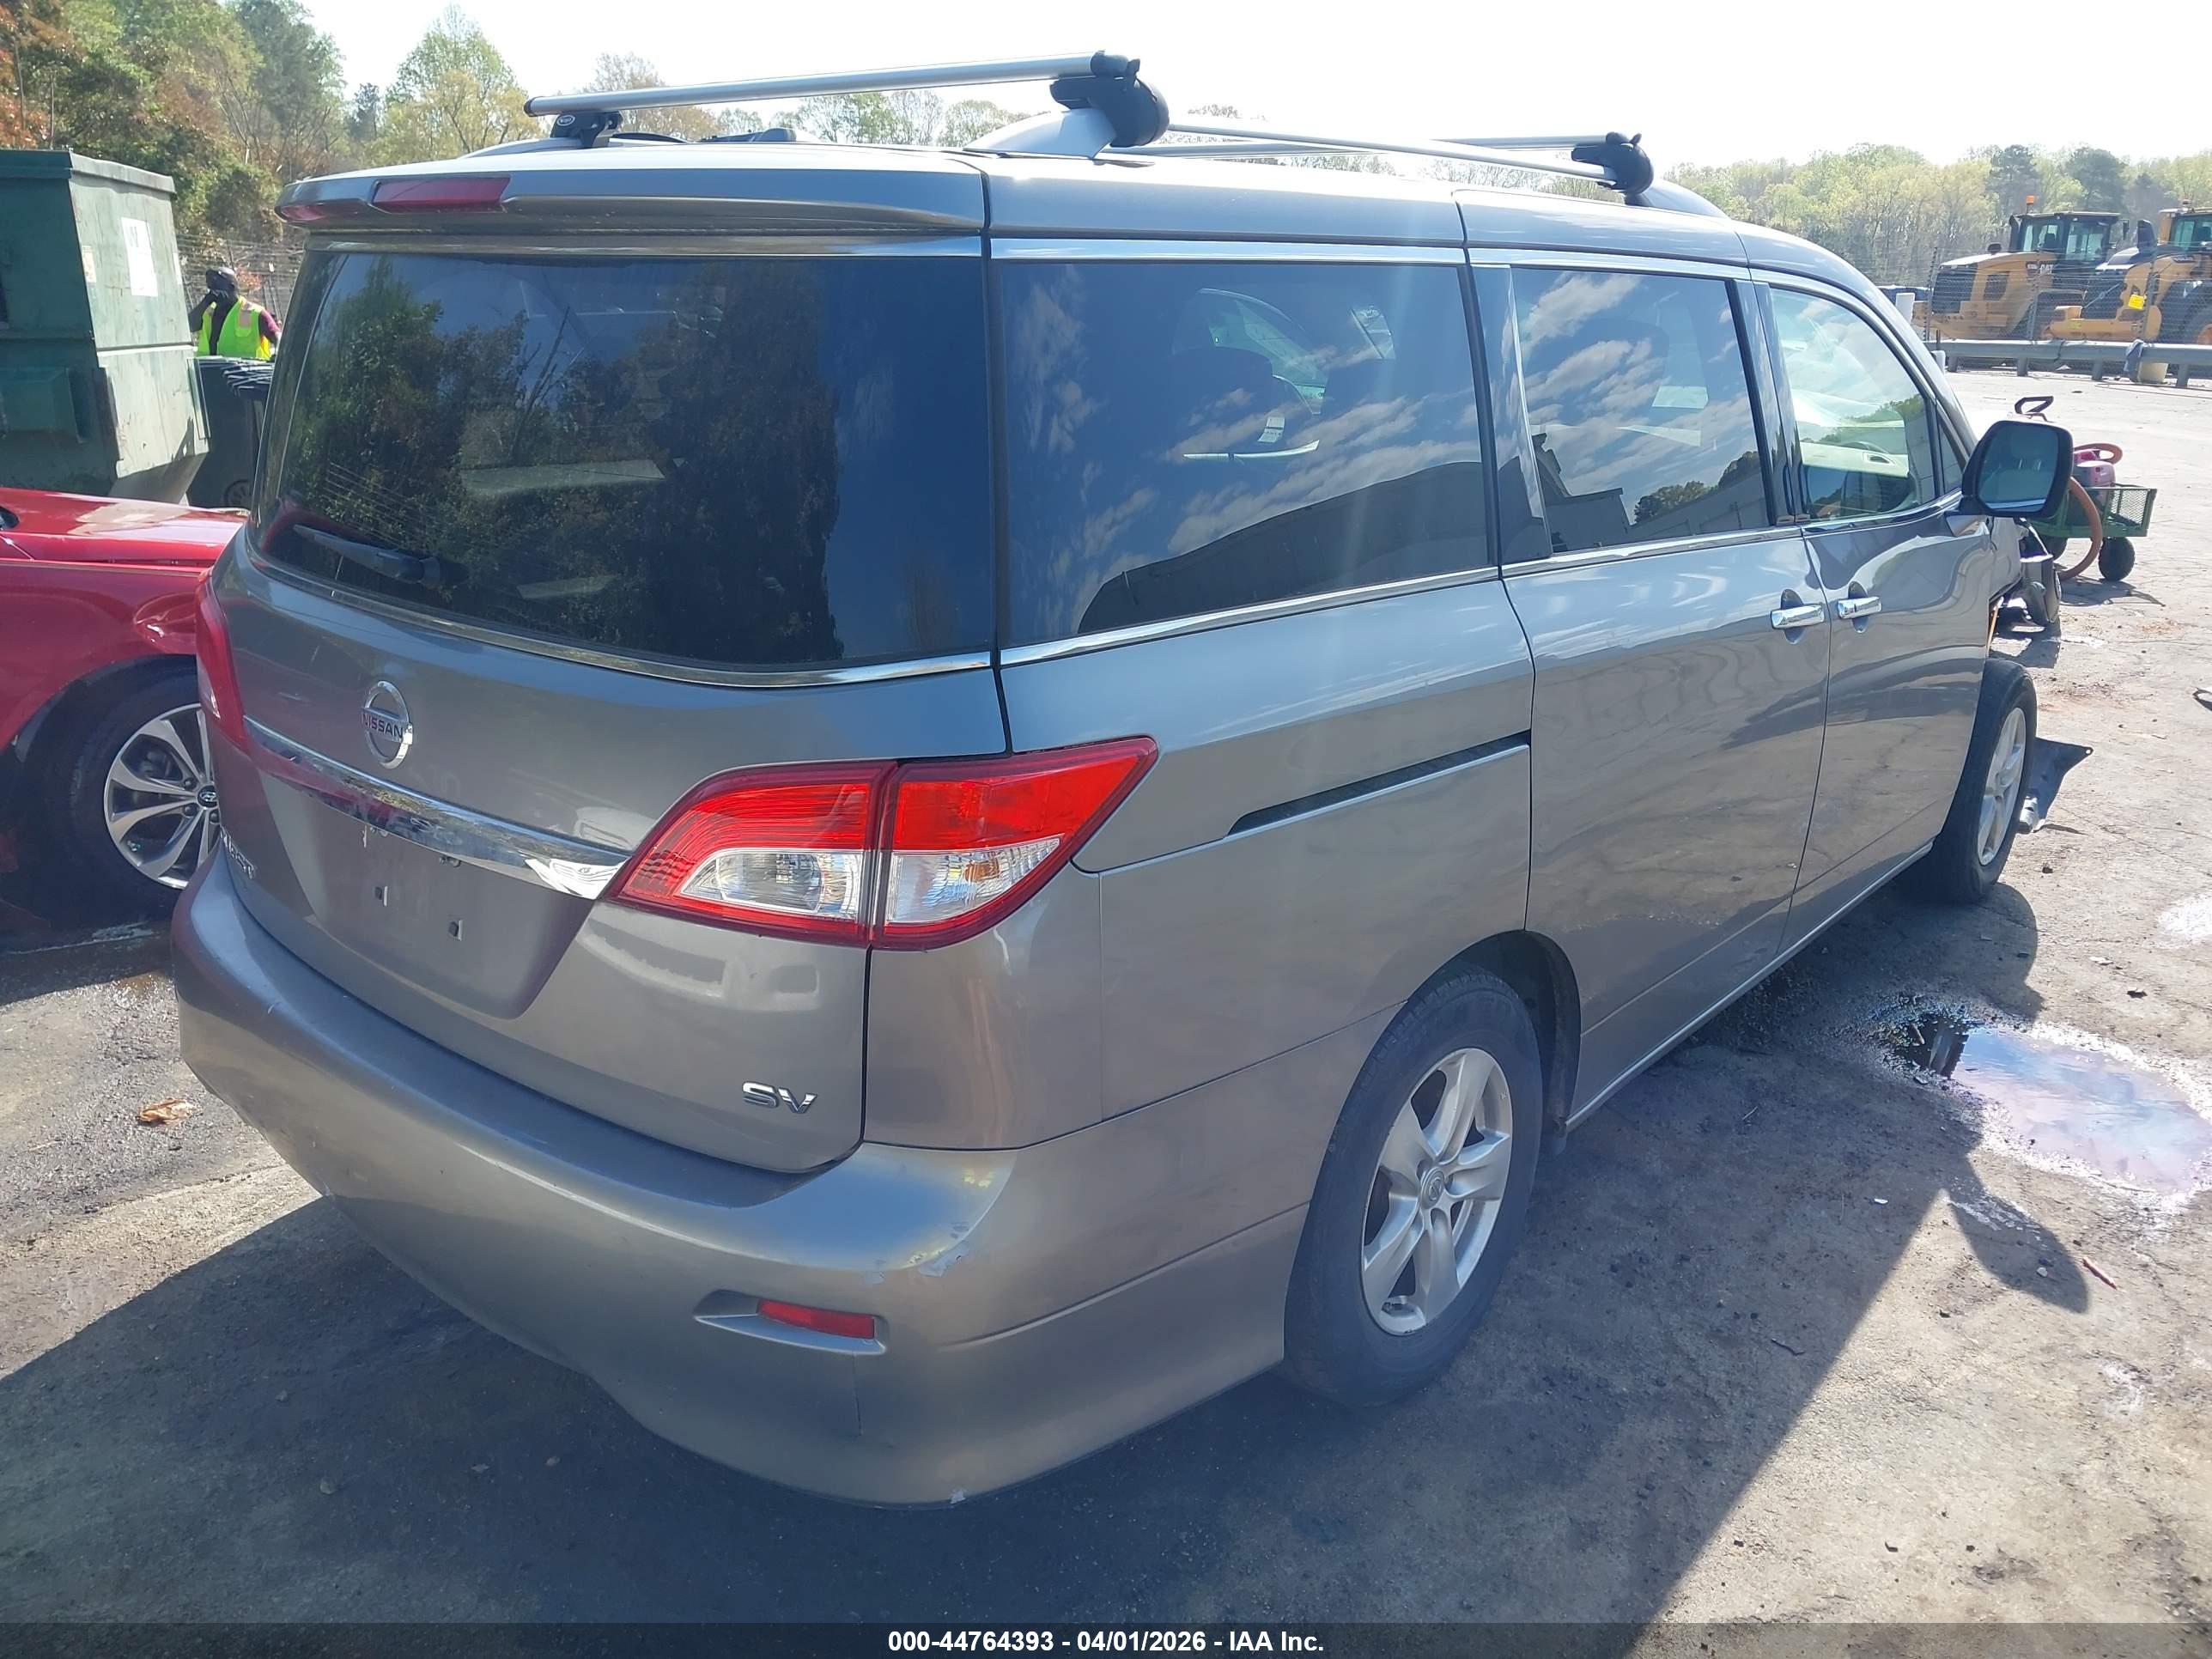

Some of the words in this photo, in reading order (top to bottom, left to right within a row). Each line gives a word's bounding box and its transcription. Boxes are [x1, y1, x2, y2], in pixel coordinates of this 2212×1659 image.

[2039, 264, 2054, 275] CAT
[361, 711, 404, 738] NISSAN
[742, 1081, 818, 1115] SV
